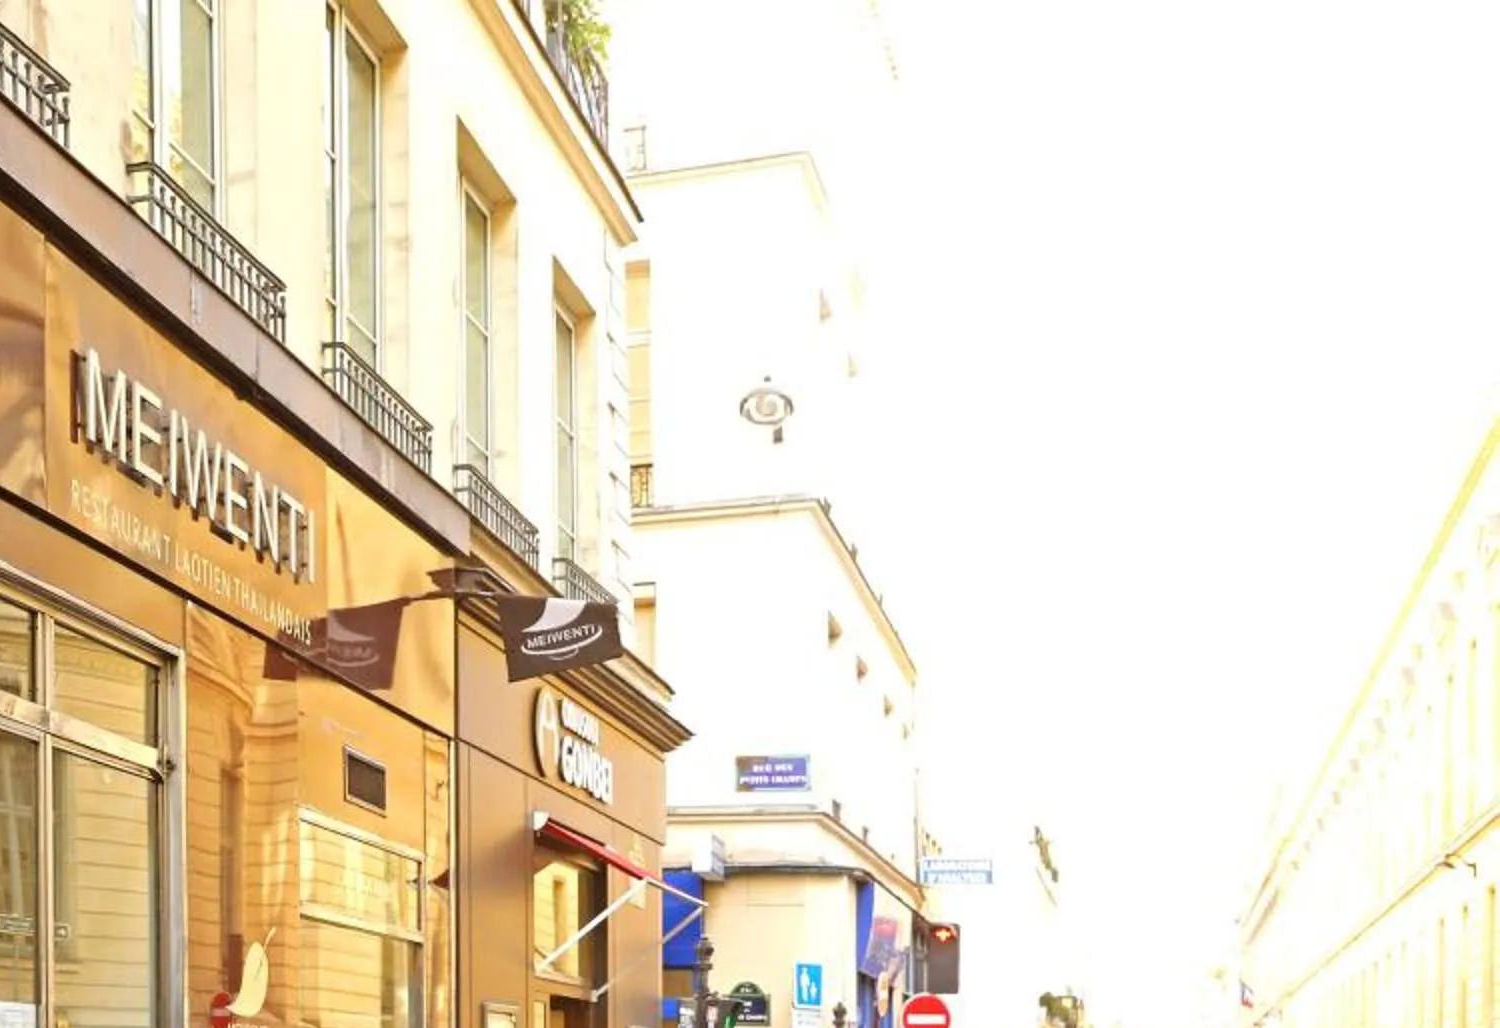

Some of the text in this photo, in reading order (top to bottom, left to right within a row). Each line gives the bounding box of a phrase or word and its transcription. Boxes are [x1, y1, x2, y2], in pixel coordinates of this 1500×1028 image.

[85, 346, 318, 584] MEIWENTI
[70, 479, 171, 565] RESTAURANT
[526, 623, 596, 650] MEIWENTI
